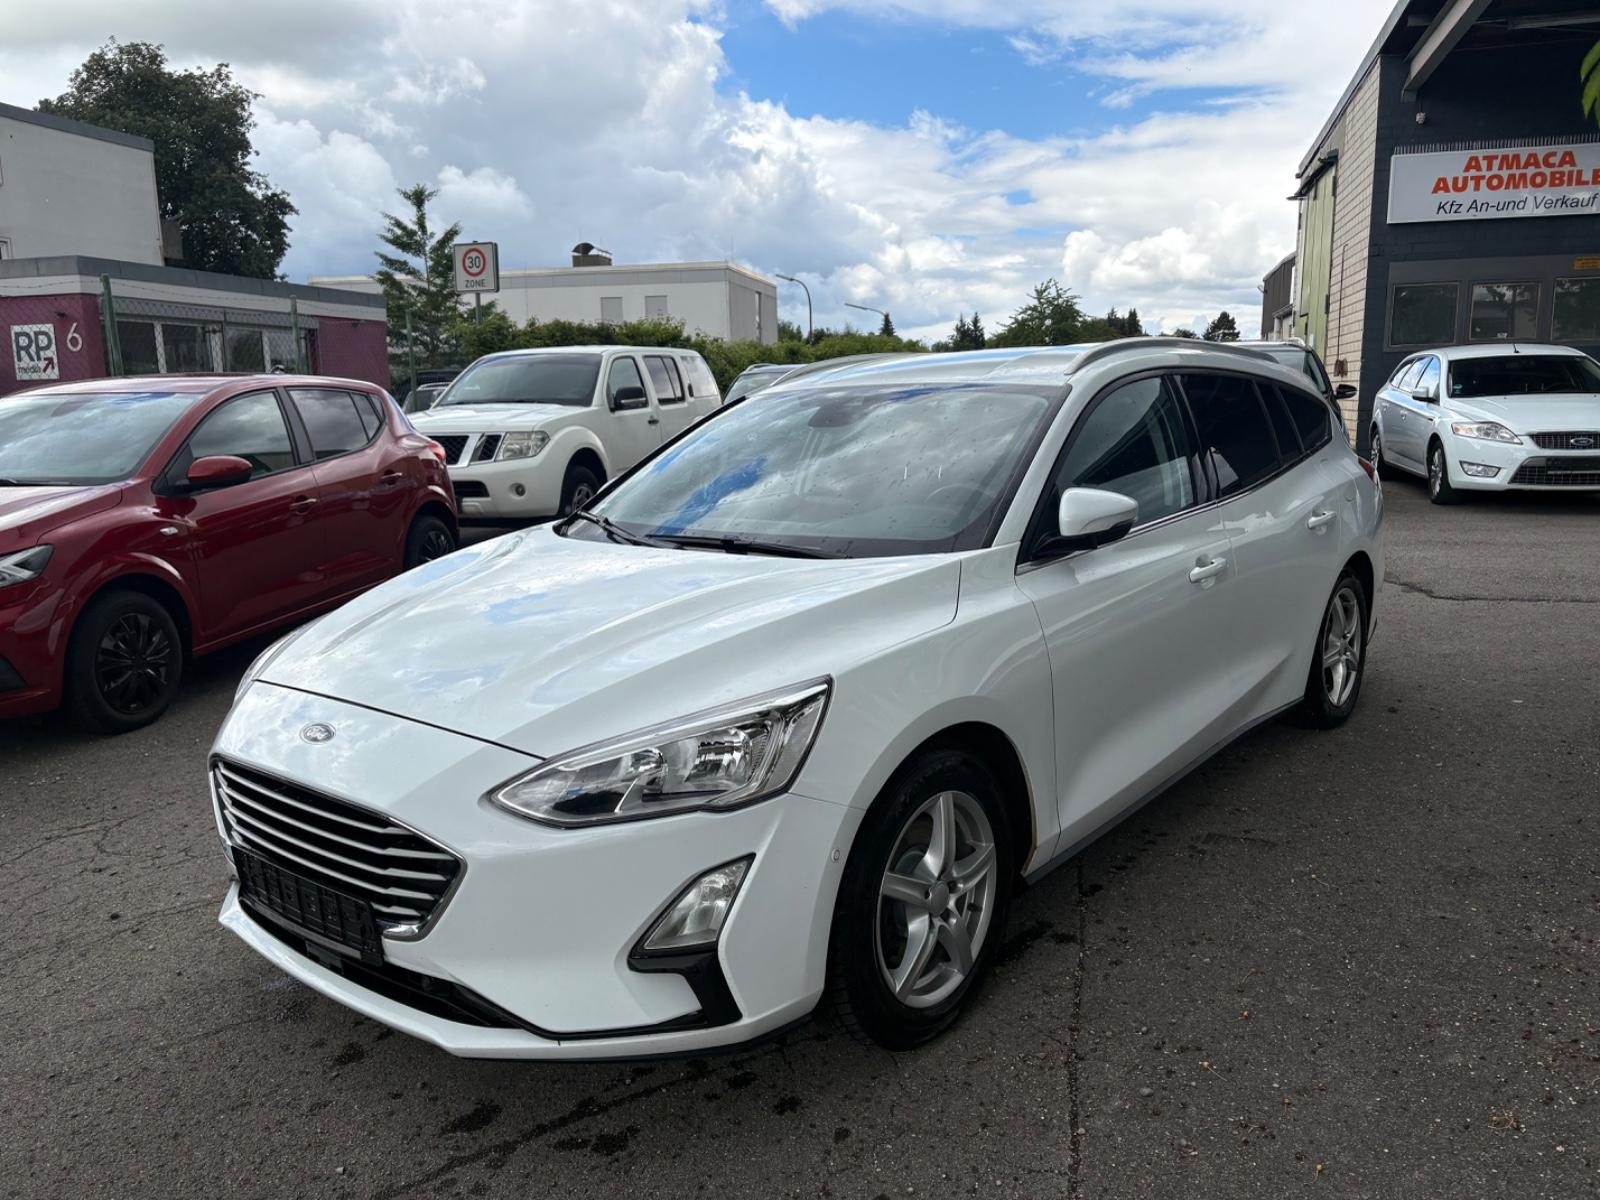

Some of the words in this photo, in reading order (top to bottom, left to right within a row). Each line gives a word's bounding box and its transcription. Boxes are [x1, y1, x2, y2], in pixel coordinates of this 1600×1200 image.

[1463, 151, 1577, 173] ATMACA
[1436, 200, 1463, 215] Kfz
[1466, 197, 1528, 213] An-und
[1533, 193, 1600, 210] Verkauf
[467, 255, 481, 269] 30
[465, 279, 486, 288] ZONE
[14, 331, 53, 362] RP
[66, 322, 83, 352] 6
